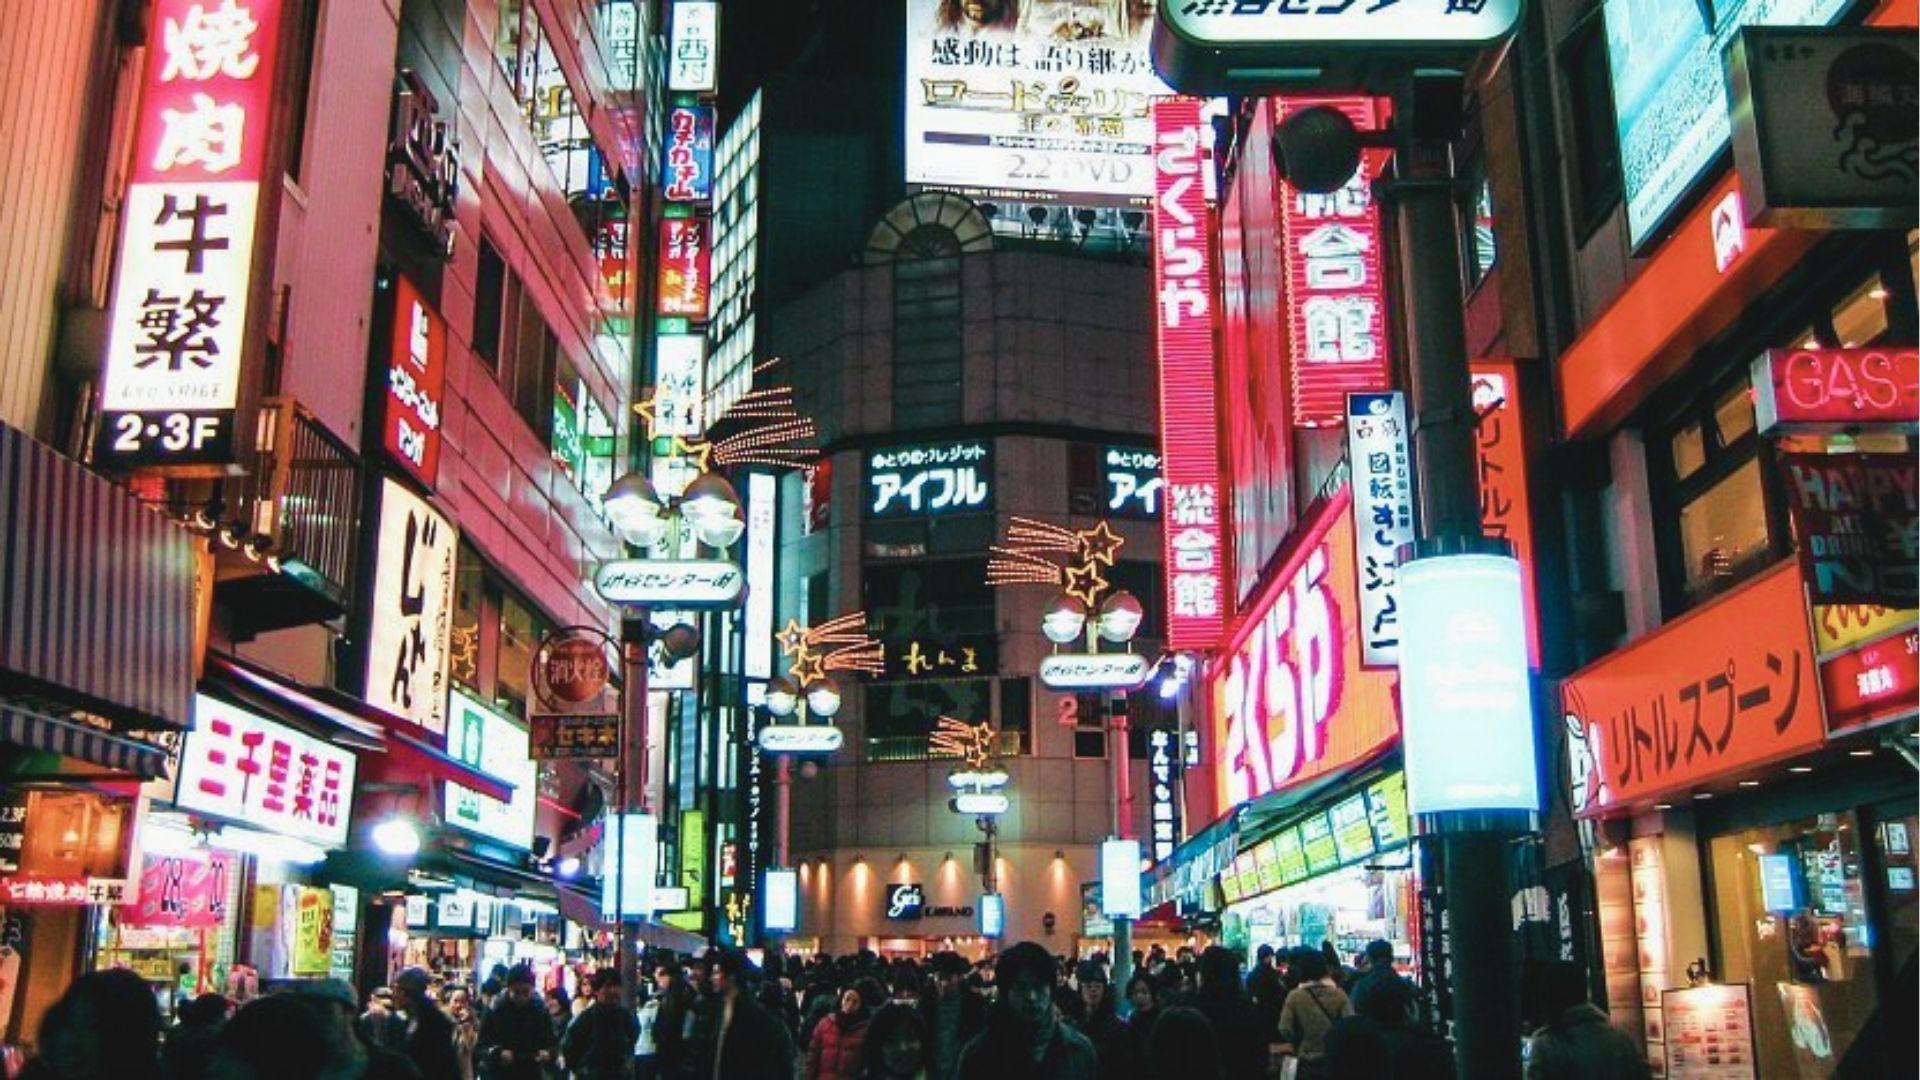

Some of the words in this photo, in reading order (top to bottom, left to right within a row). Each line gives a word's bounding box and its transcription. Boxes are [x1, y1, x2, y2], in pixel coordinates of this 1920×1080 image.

[135, 194, 230, 371] 牛繁
[1156, 124, 1209, 328] さくらや
[871, 467, 987, 513] アイフル
[1171, 484, 1218, 617] 総合館
[1611, 650, 1801, 788] リトルスプーン
